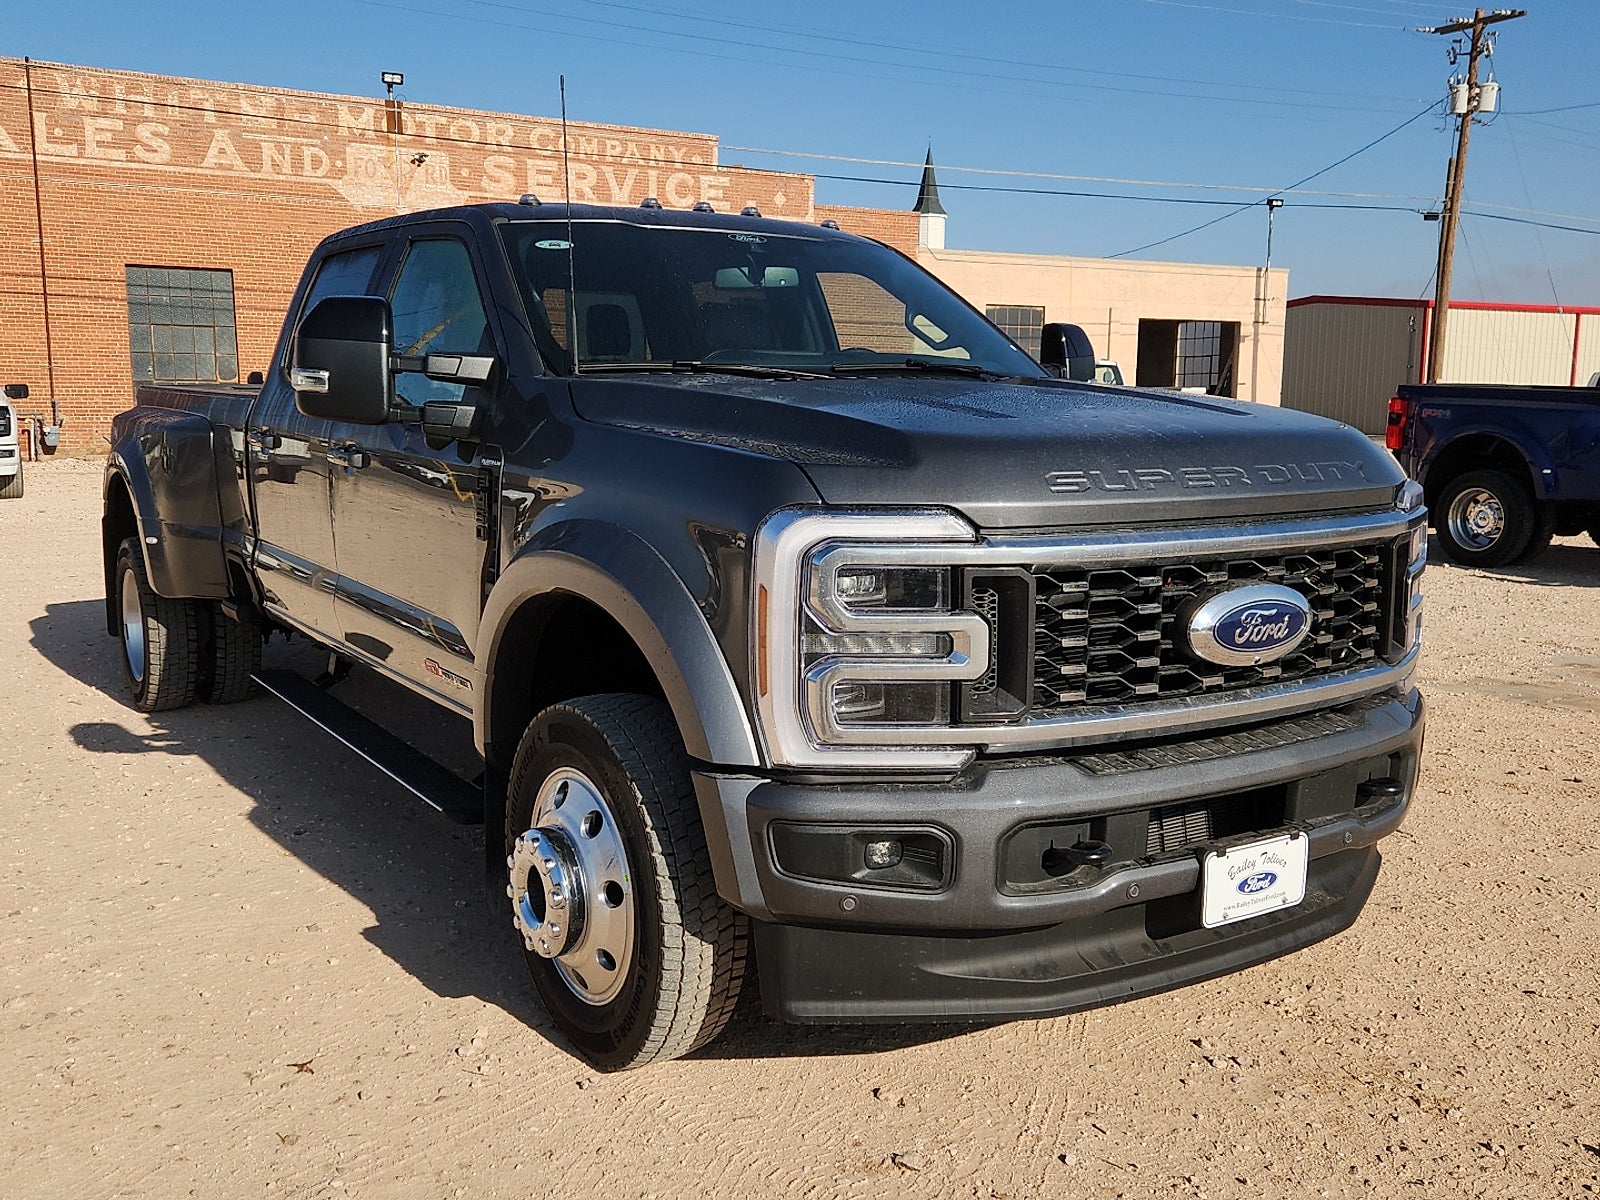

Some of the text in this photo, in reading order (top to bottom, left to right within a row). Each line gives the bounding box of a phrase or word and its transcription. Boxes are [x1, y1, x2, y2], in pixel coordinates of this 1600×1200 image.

[528, 126, 687, 168] COMPANY
[200, 129, 332, 178] AND
[480, 154, 730, 210] SERVICE
[1045, 460, 1372, 494] SUPER DUTY
[1234, 608, 1290, 645] Ford
[1244, 873, 1272, 892] Ford
